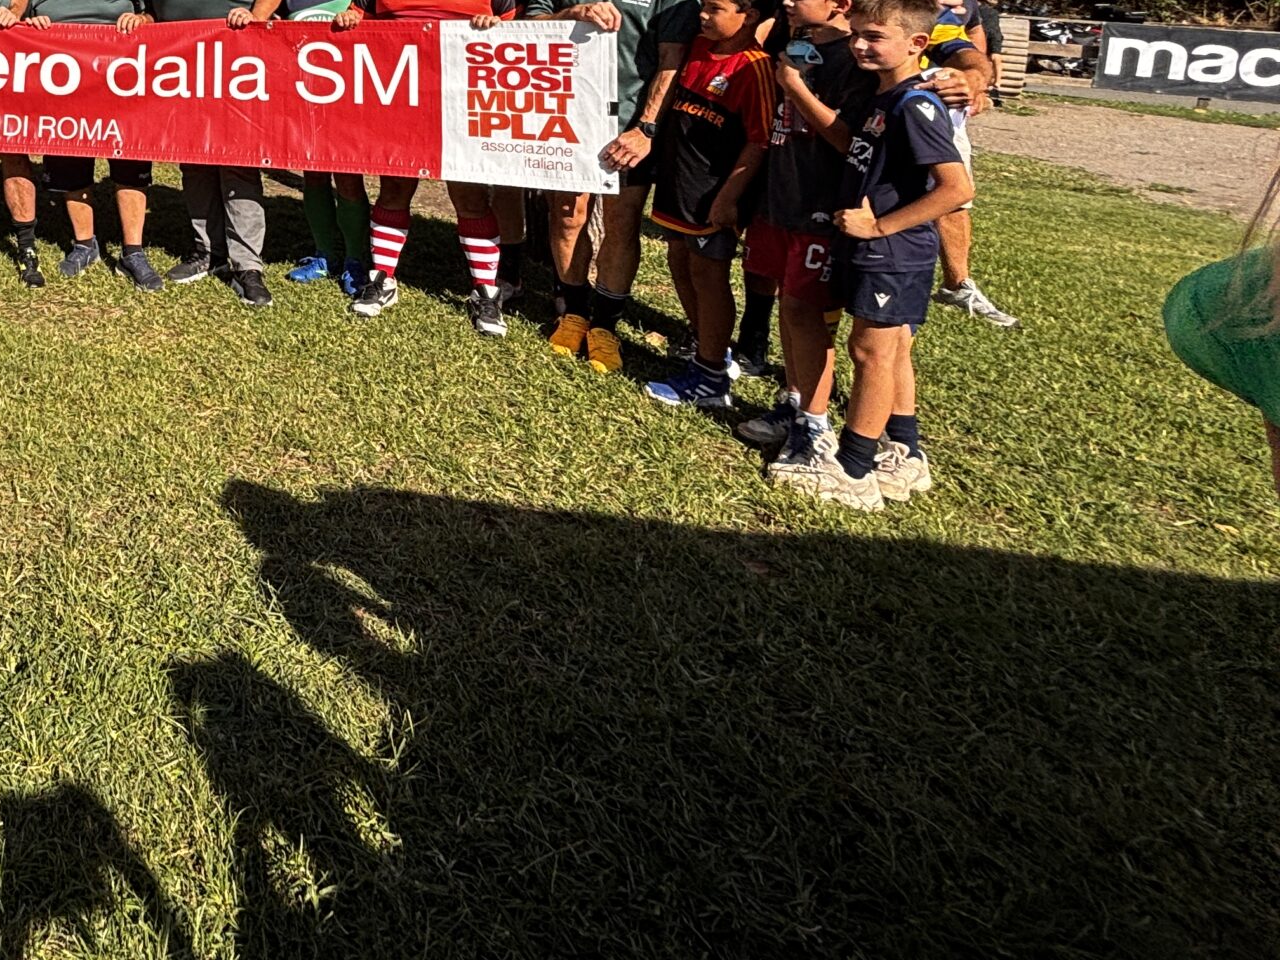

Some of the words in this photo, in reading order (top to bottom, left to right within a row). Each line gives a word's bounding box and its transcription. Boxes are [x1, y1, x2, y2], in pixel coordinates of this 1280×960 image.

[465, 41, 575, 67] SCLE
[1104, 36, 1280, 88] mac
[105, 40, 271, 102] dalla
[294, 41, 420, 107] SM
[466, 89, 576, 115] MULT
[2, 113, 29, 138] DI
[37, 116, 122, 141] ROMA
[480, 140, 574, 158] associazione
[524, 157, 574, 172] italiana
